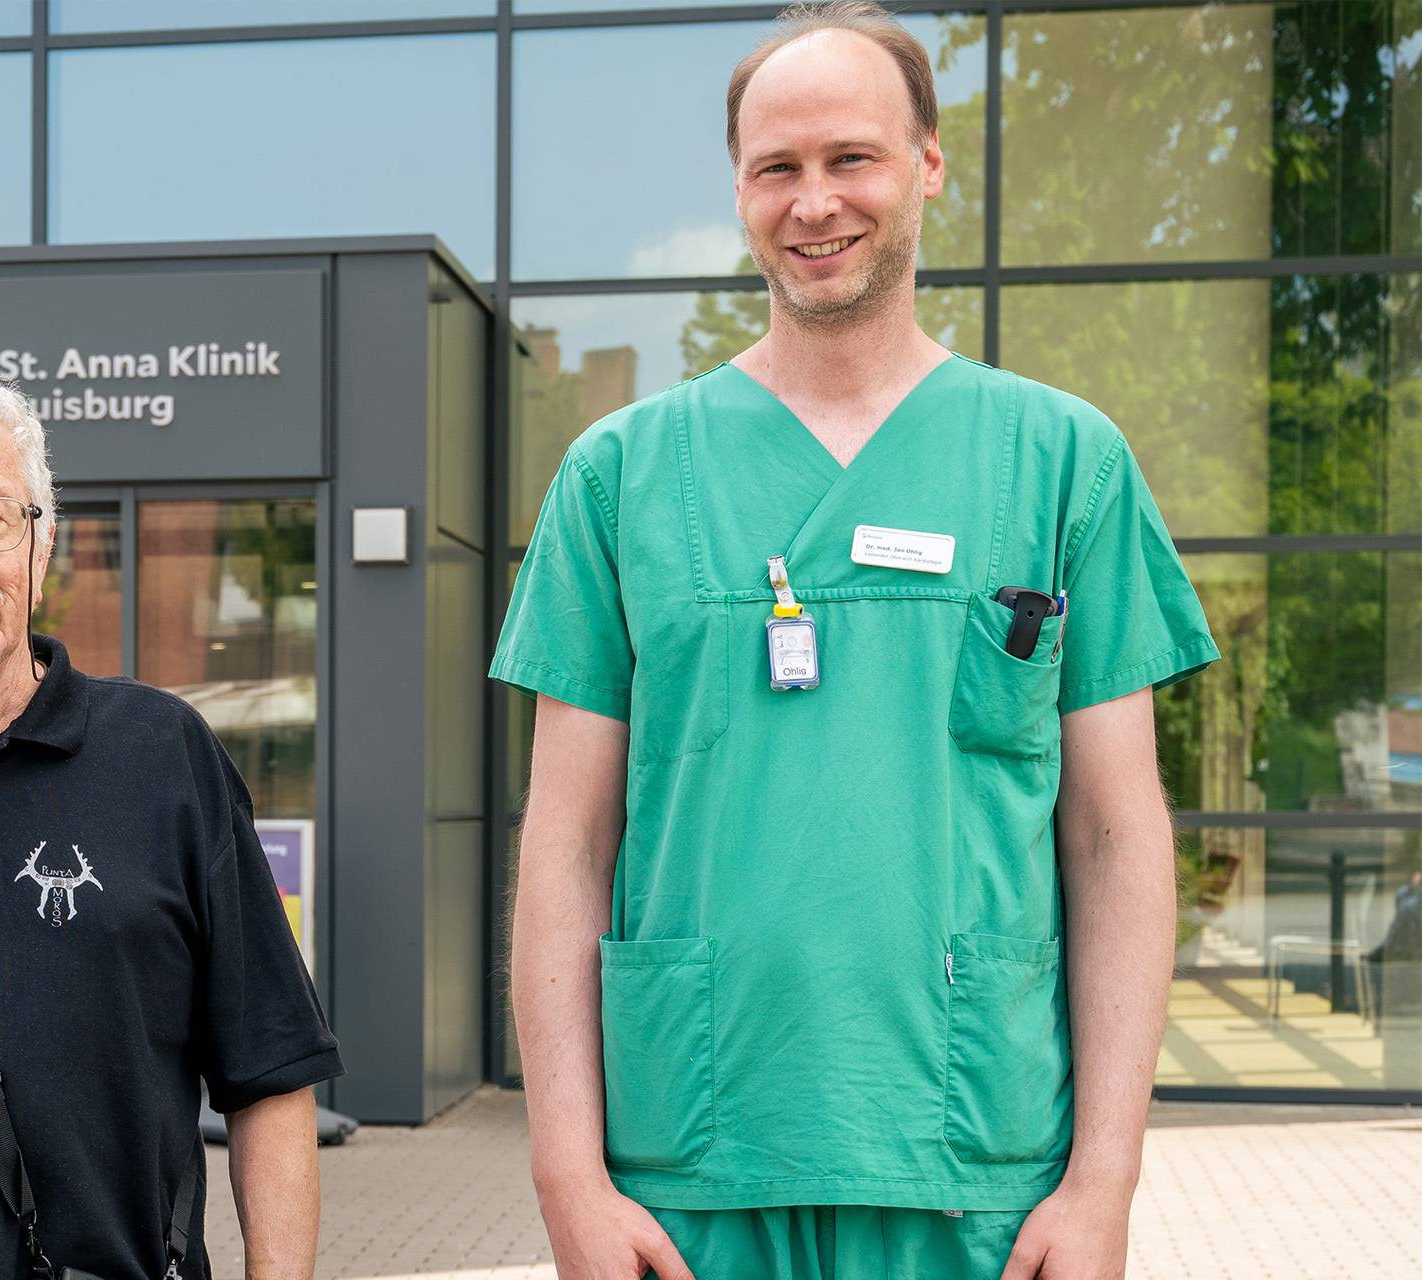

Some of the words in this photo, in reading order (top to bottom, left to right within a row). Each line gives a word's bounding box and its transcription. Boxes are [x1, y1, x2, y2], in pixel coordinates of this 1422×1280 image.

[56, 348, 159, 380] Anna
[168, 342, 280, 377] Klinik
[30, 387, 175, 427] uisburg
[782, 667, 807, 677] Ohlig
